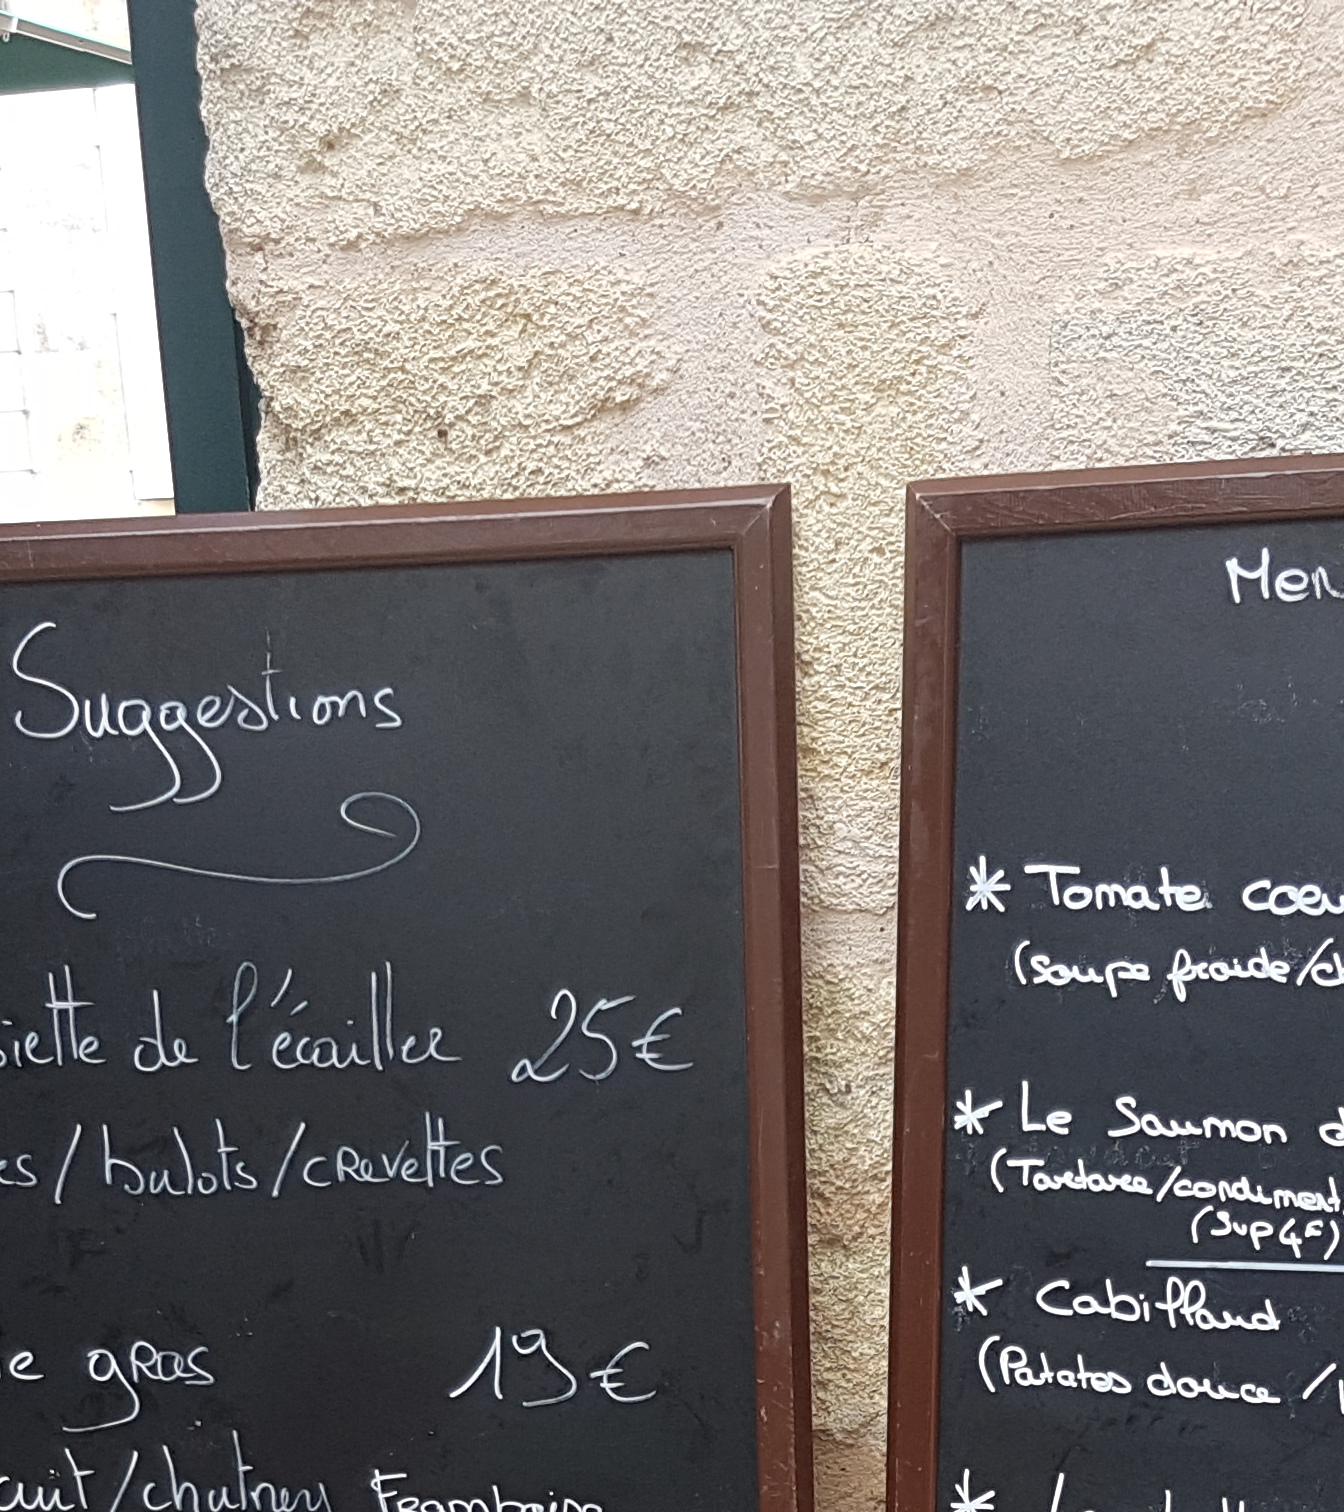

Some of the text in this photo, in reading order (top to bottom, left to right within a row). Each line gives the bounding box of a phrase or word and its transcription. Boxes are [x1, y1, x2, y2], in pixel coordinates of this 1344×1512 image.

[11, 620, 403, 812] Suggestions
[1023, 861, 1208, 912] Tomate
[1013, 939, 1151, 999] (soupe
[133, 989, 199, 1072] de
[225, 960, 462, 1071] l'écailler
[510, 988, 694, 1083] 25€
[1020, 1079, 1073, 1136] Le
[1107, 1094, 1288, 1145] Saumon
[1035, 1275, 1282, 1331] Cabillaud
[62, 1340, 215, 1432] gras
[1146, 1361, 1282, 1404] douce
